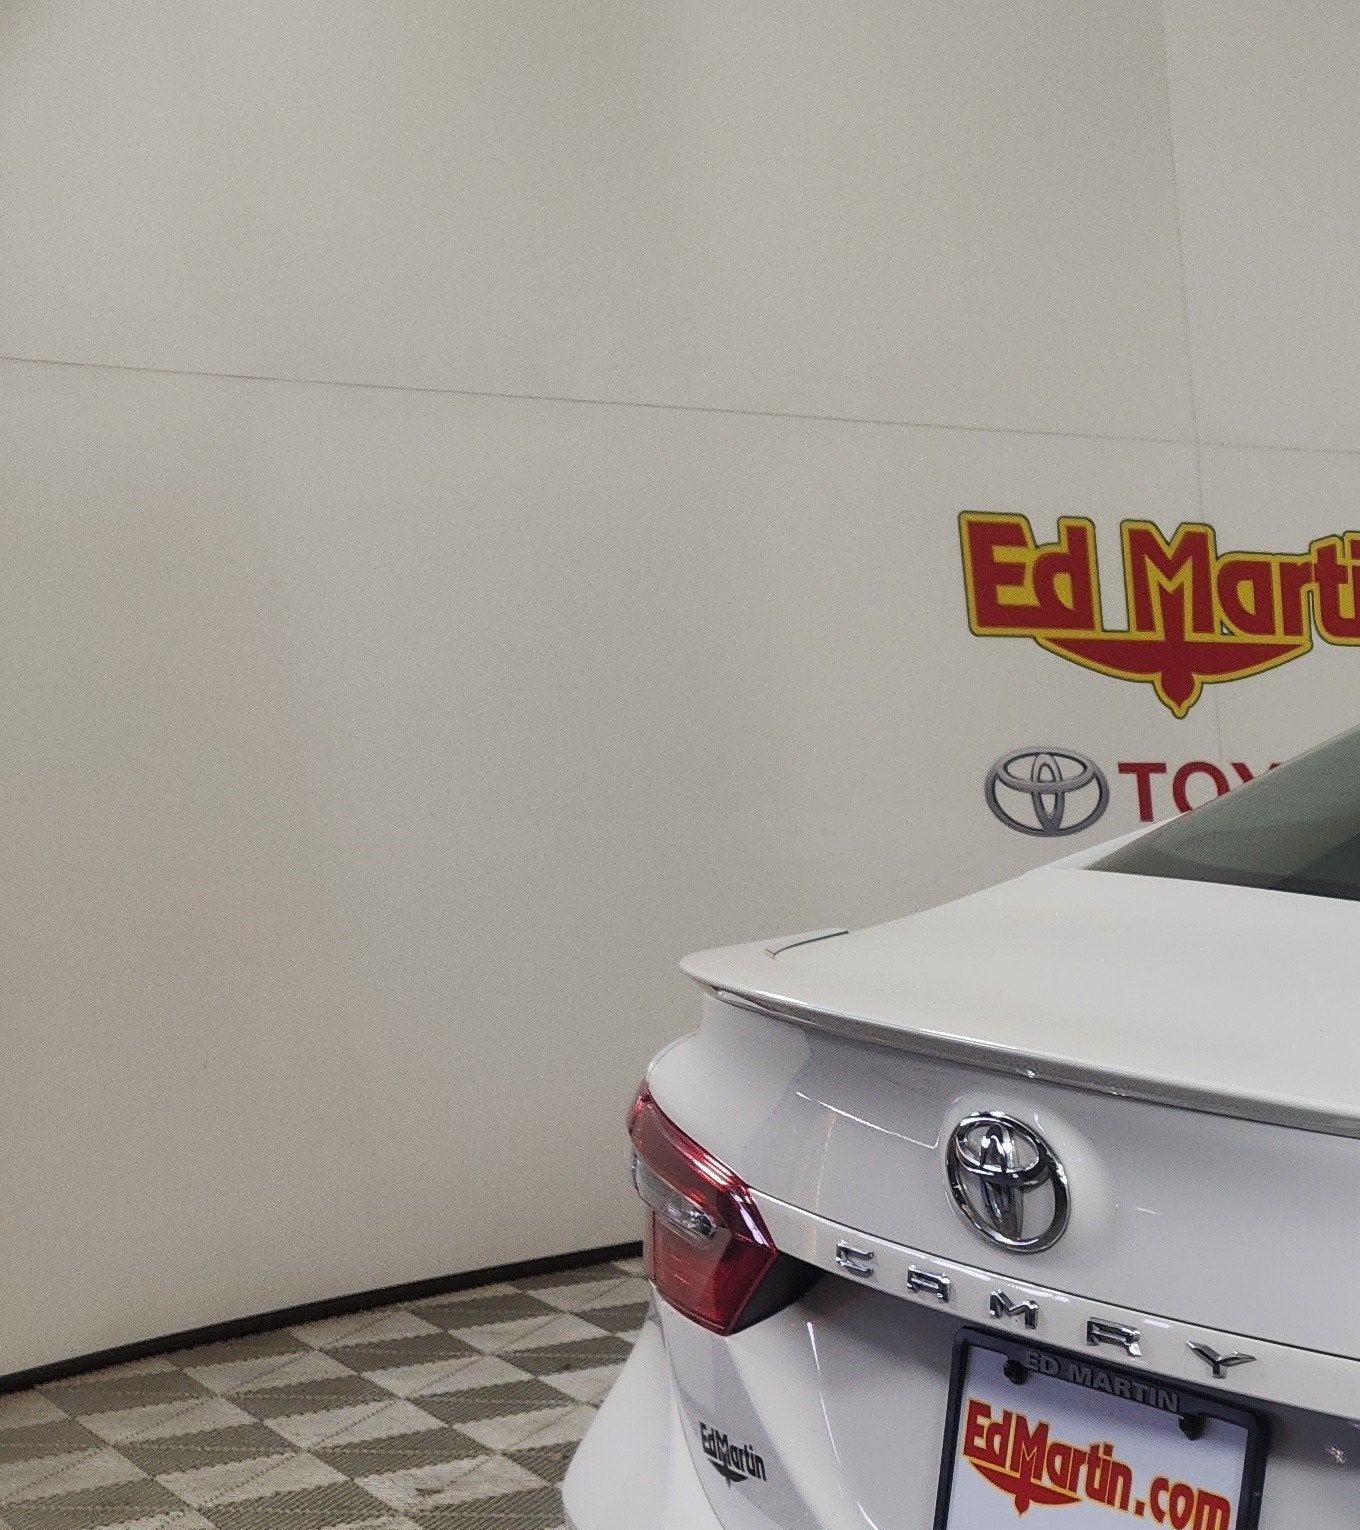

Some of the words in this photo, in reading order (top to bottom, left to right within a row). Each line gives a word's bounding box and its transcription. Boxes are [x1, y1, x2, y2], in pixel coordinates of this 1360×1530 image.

[958, 510, 1104, 637] Ed
[834, 1240, 1257, 1378] CAMRY
[1023, 1350, 1060, 1376] ED
[1069, 1362, 1181, 1414] MARTIN
